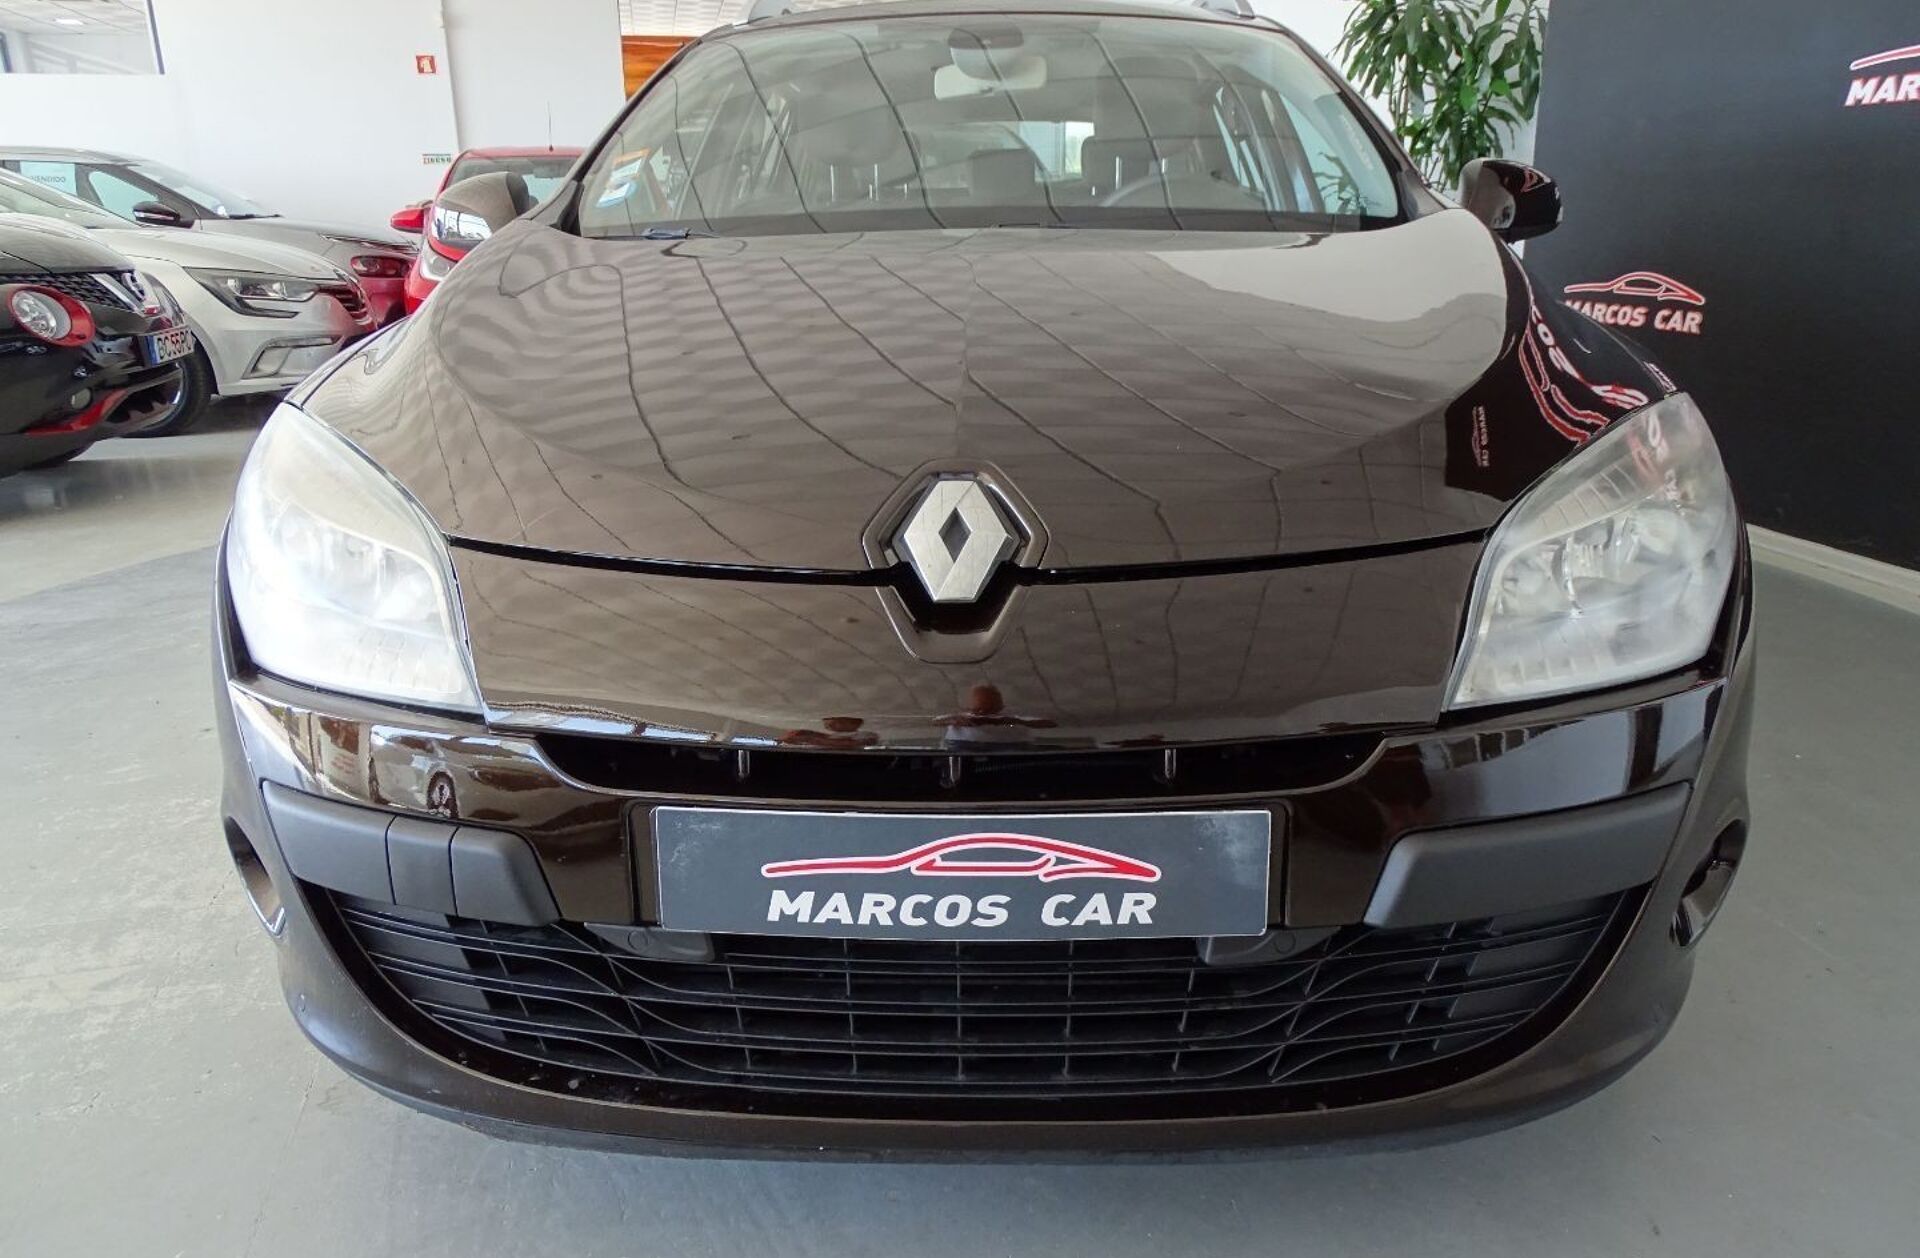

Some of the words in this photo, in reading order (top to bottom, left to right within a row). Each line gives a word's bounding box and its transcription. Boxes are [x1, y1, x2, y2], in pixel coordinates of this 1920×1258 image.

[1653, 308, 1704, 335] CAR
[767, 889, 1012, 927] MARCOS
[1040, 892, 1157, 926] CAR
